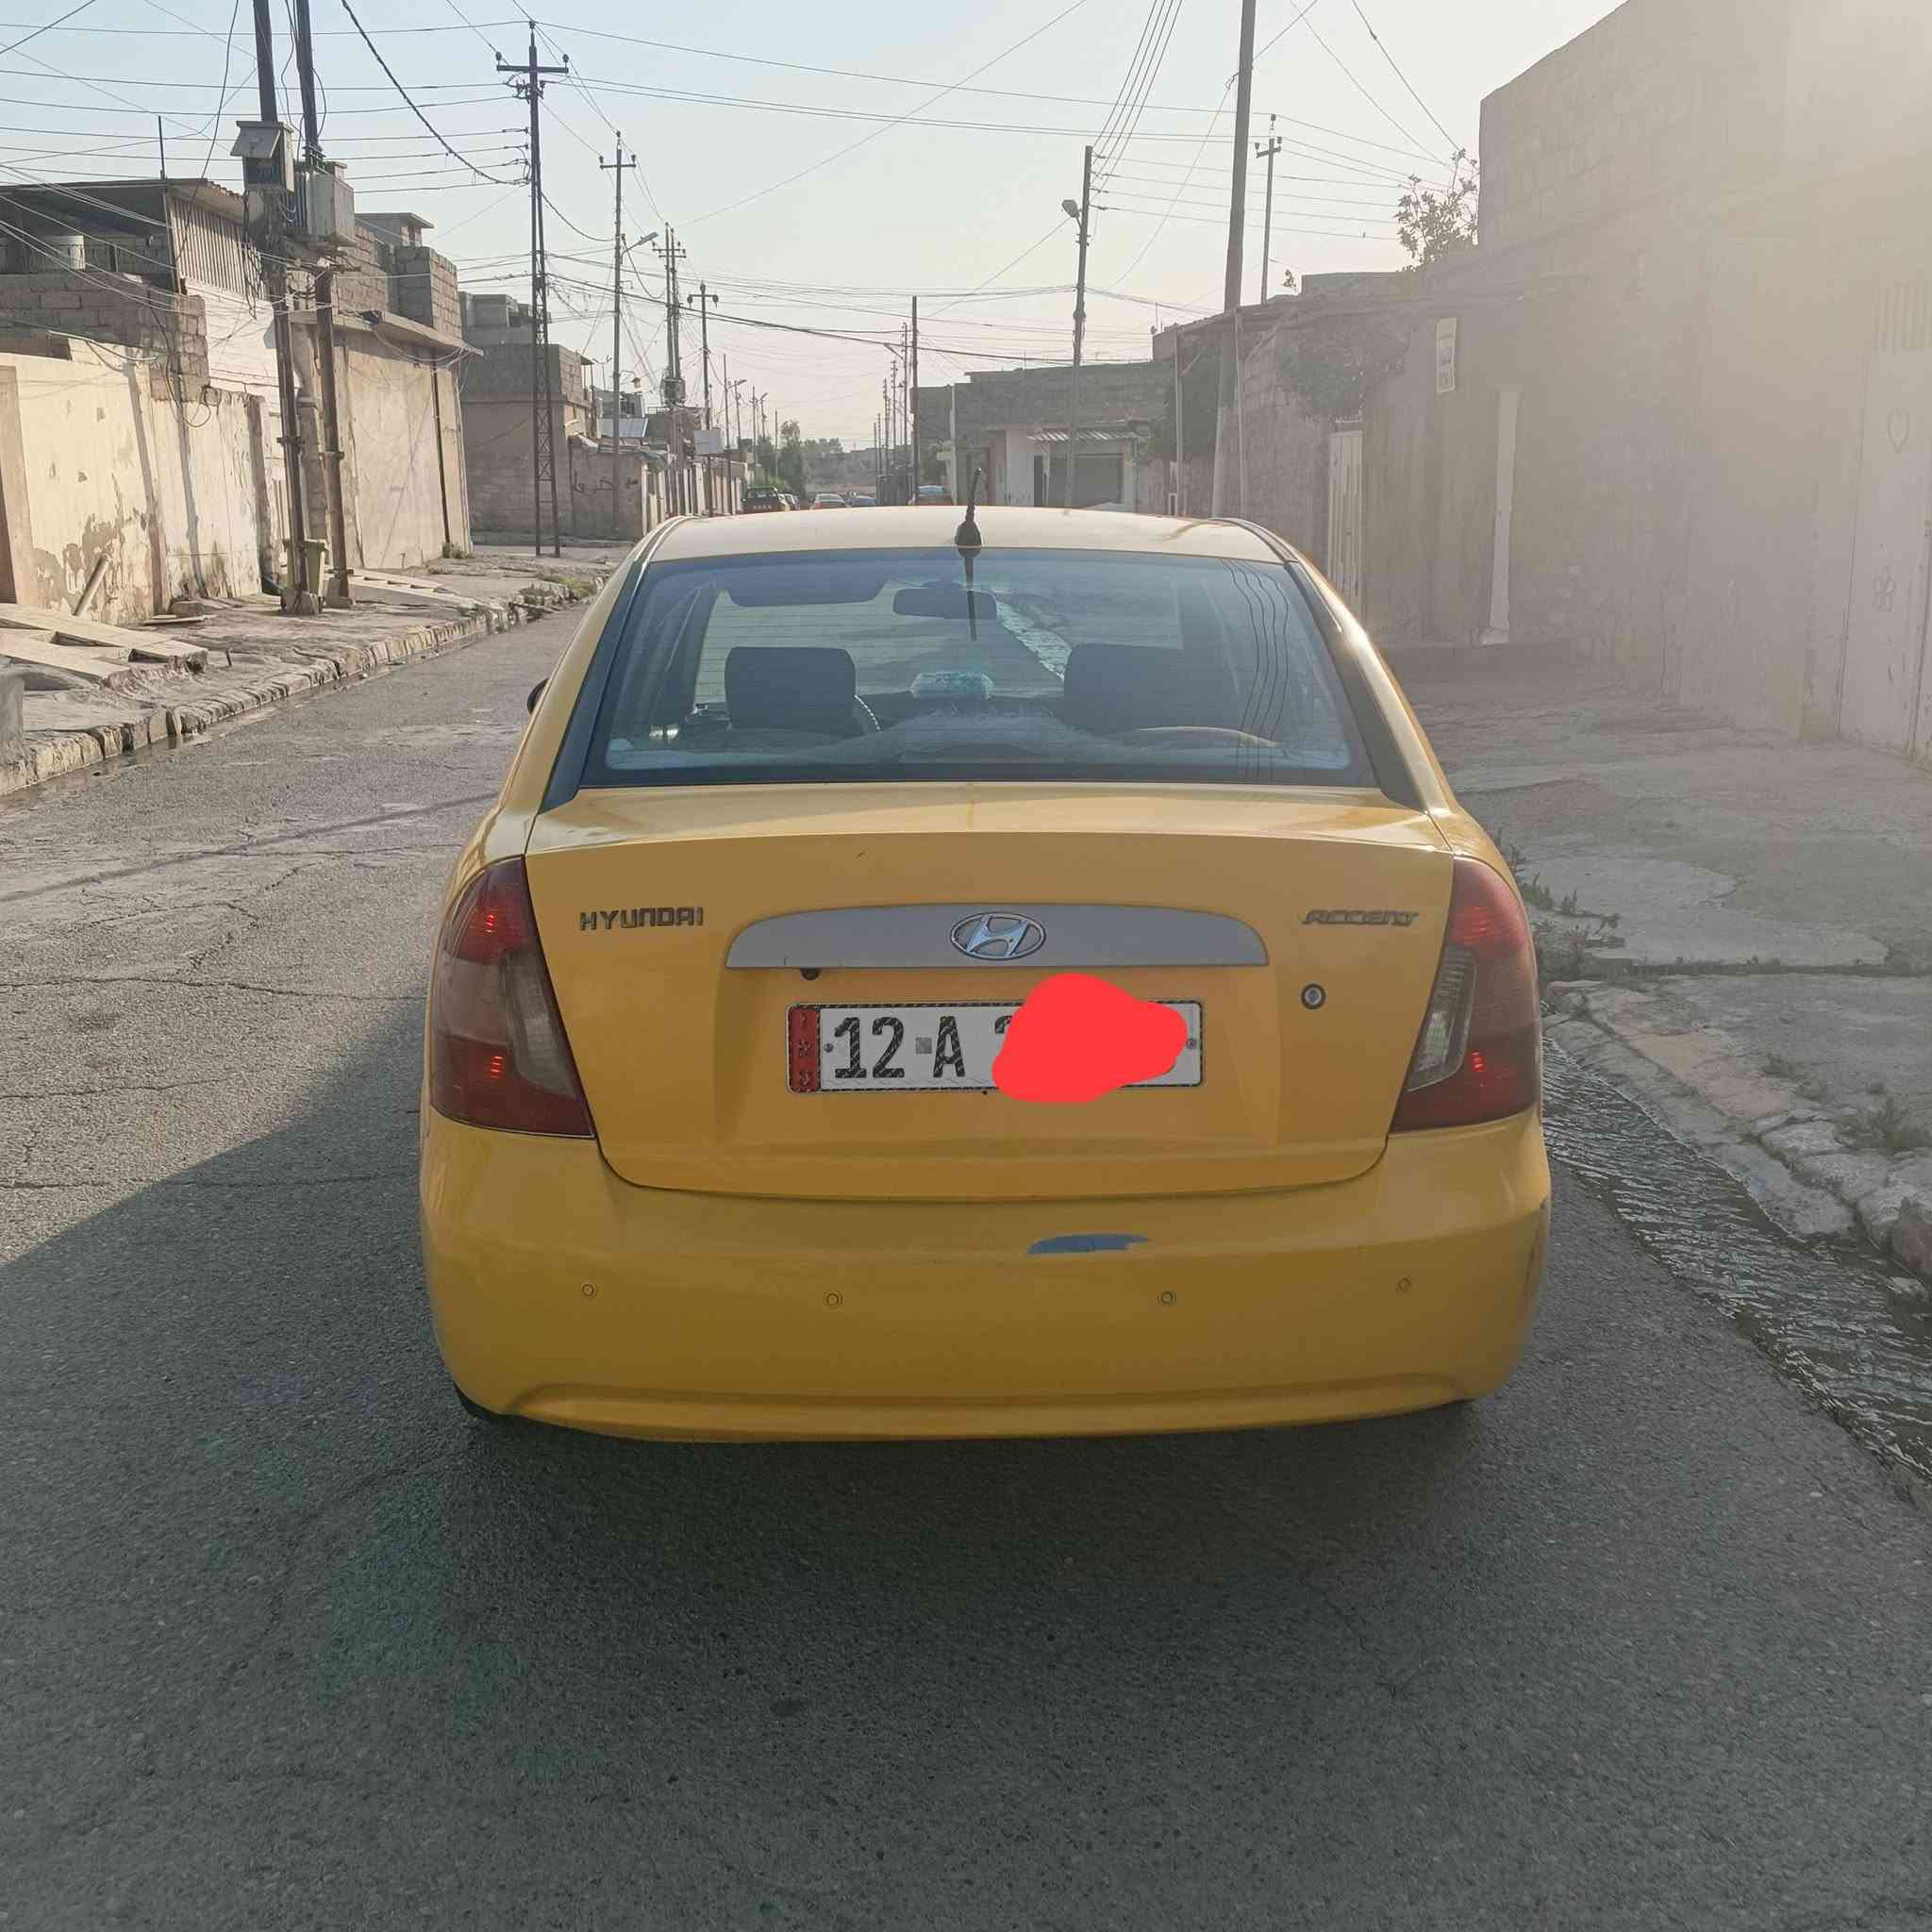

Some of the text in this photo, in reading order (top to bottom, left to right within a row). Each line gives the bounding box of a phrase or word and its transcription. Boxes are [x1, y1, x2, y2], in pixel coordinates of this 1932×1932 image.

[579, 907, 704, 931] HYUNDAI
[1301, 909, 1420, 926] ACCENT
[834, 1016, 905, 1078] 12
[933, 1016, 965, 1077] A
